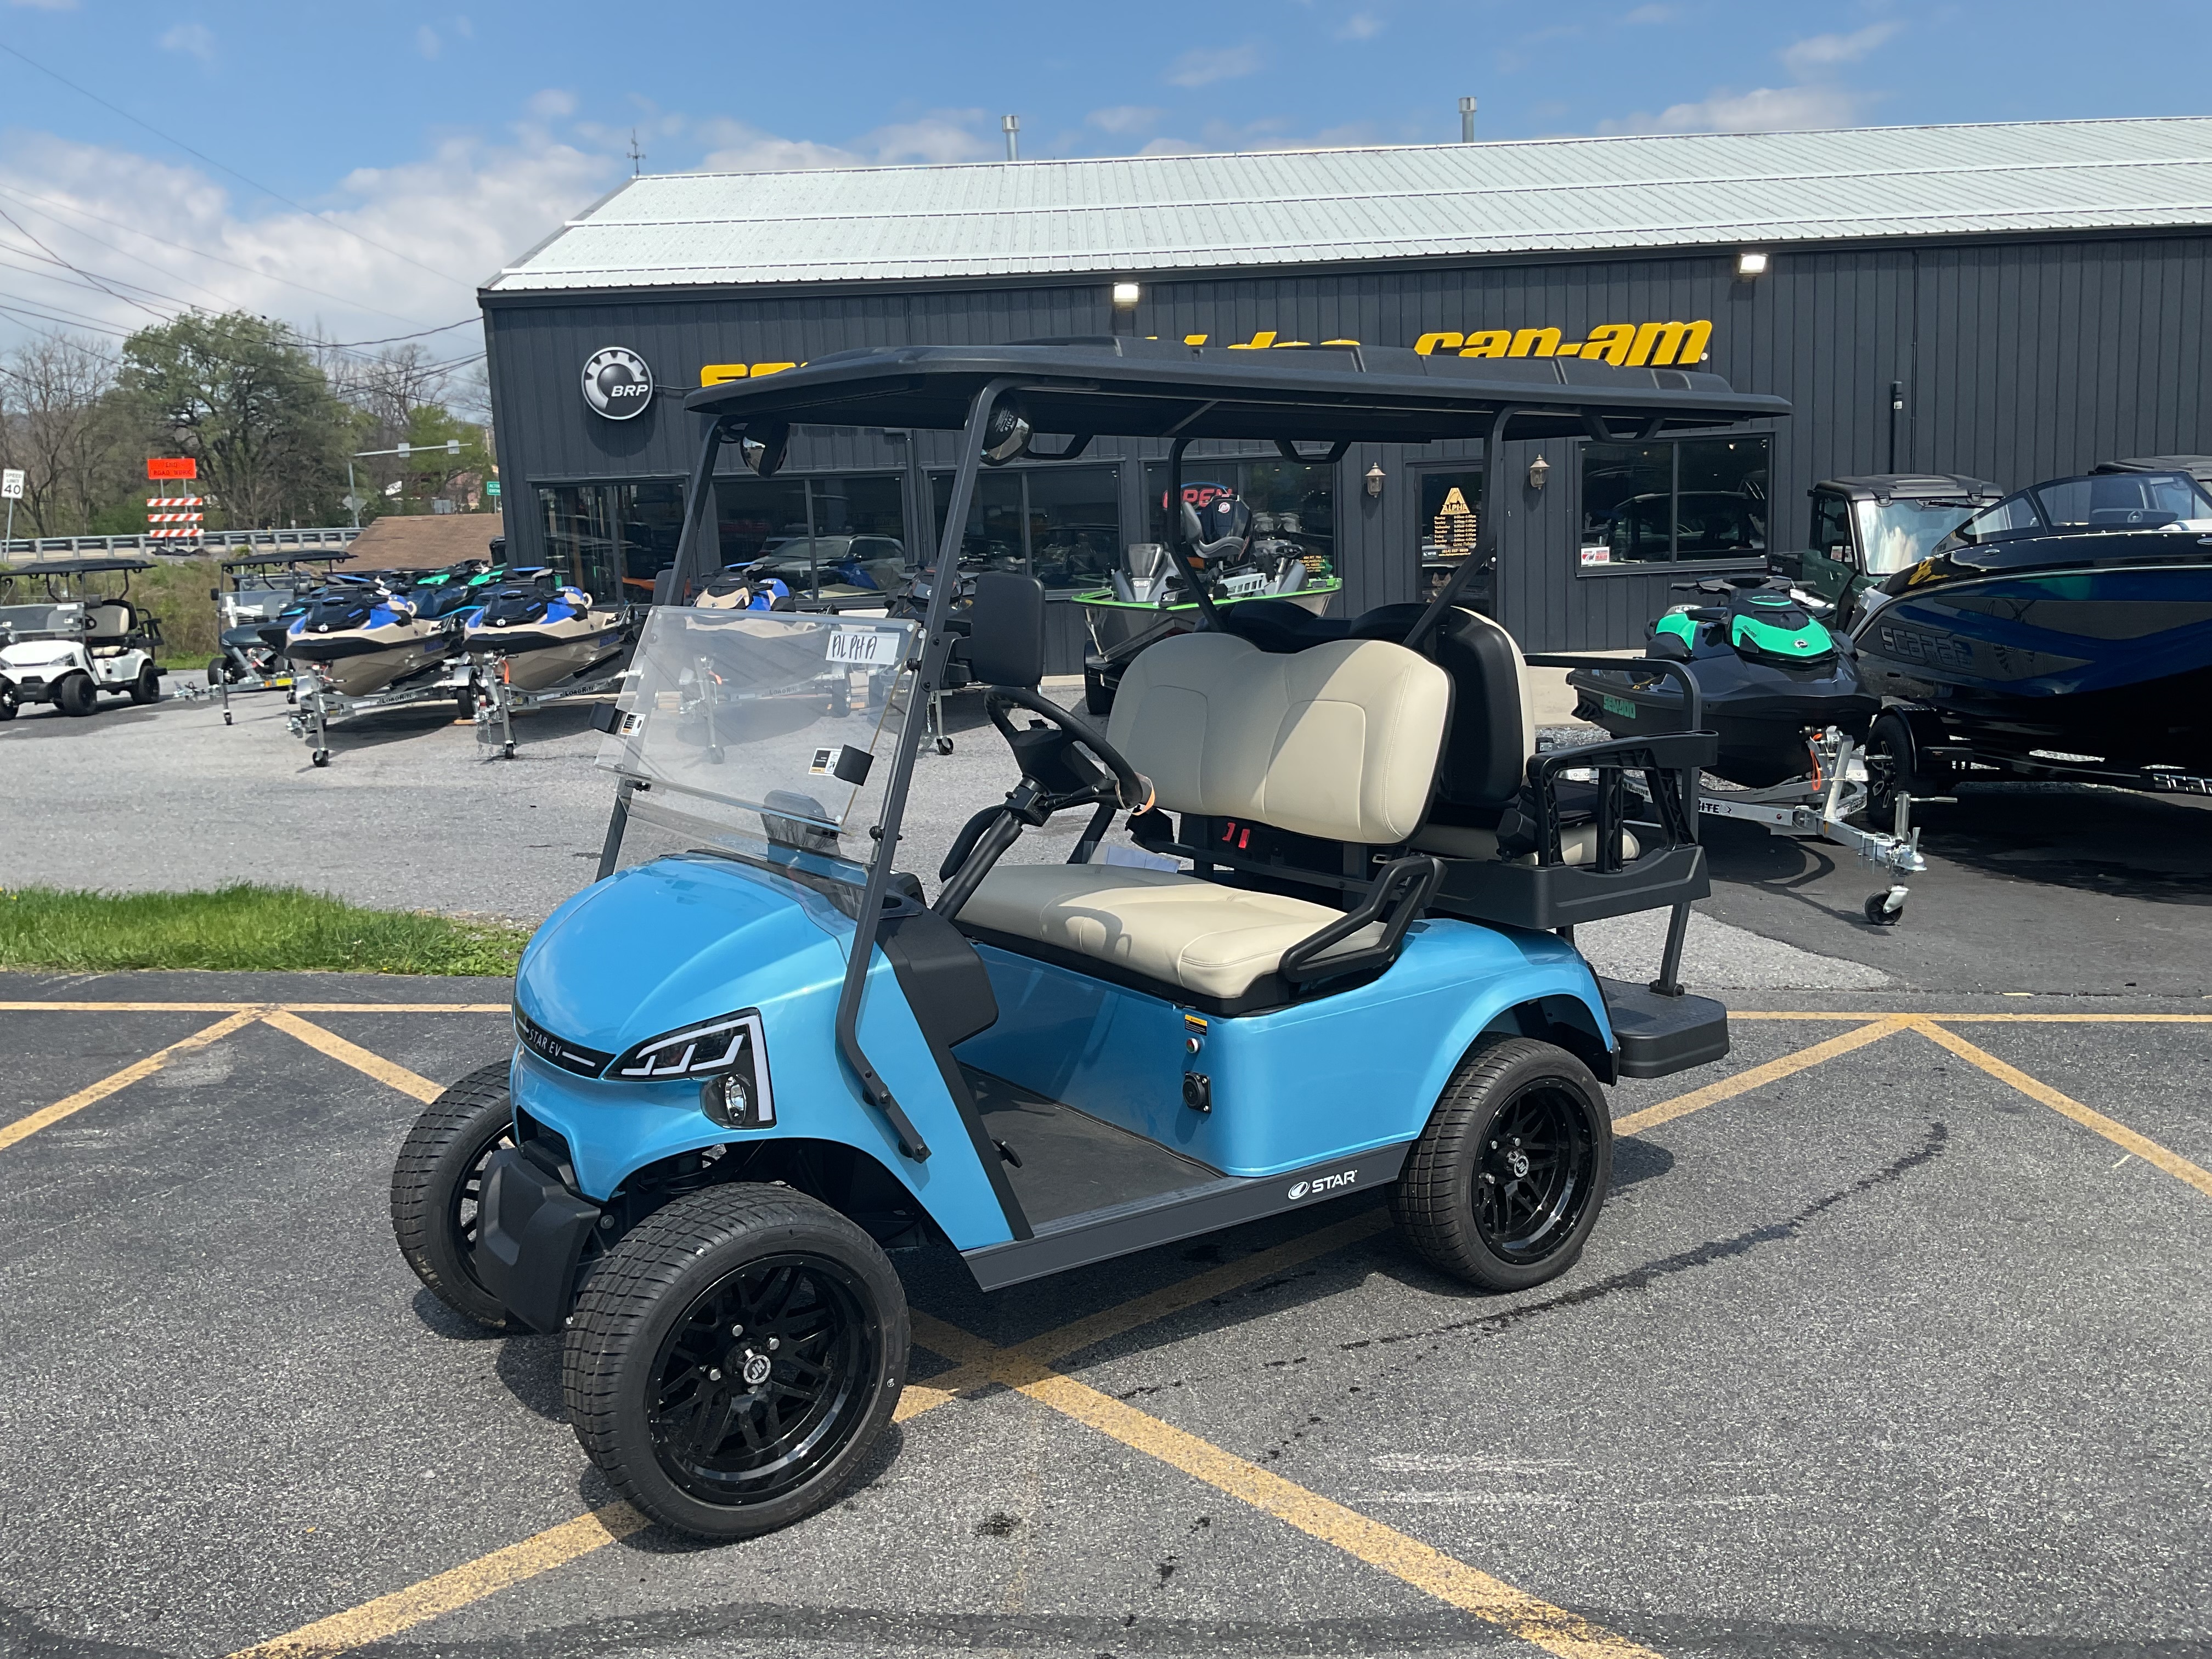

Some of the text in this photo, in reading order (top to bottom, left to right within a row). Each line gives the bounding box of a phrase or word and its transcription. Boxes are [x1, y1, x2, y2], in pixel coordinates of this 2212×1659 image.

[611, 385, 648, 397] BRP
[4, 484, 21, 494] 40
[832, 635, 877, 660] ALPHA
[529, 1029, 562, 1057] STAR EV
[1312, 1170, 1355, 1193] STAR
